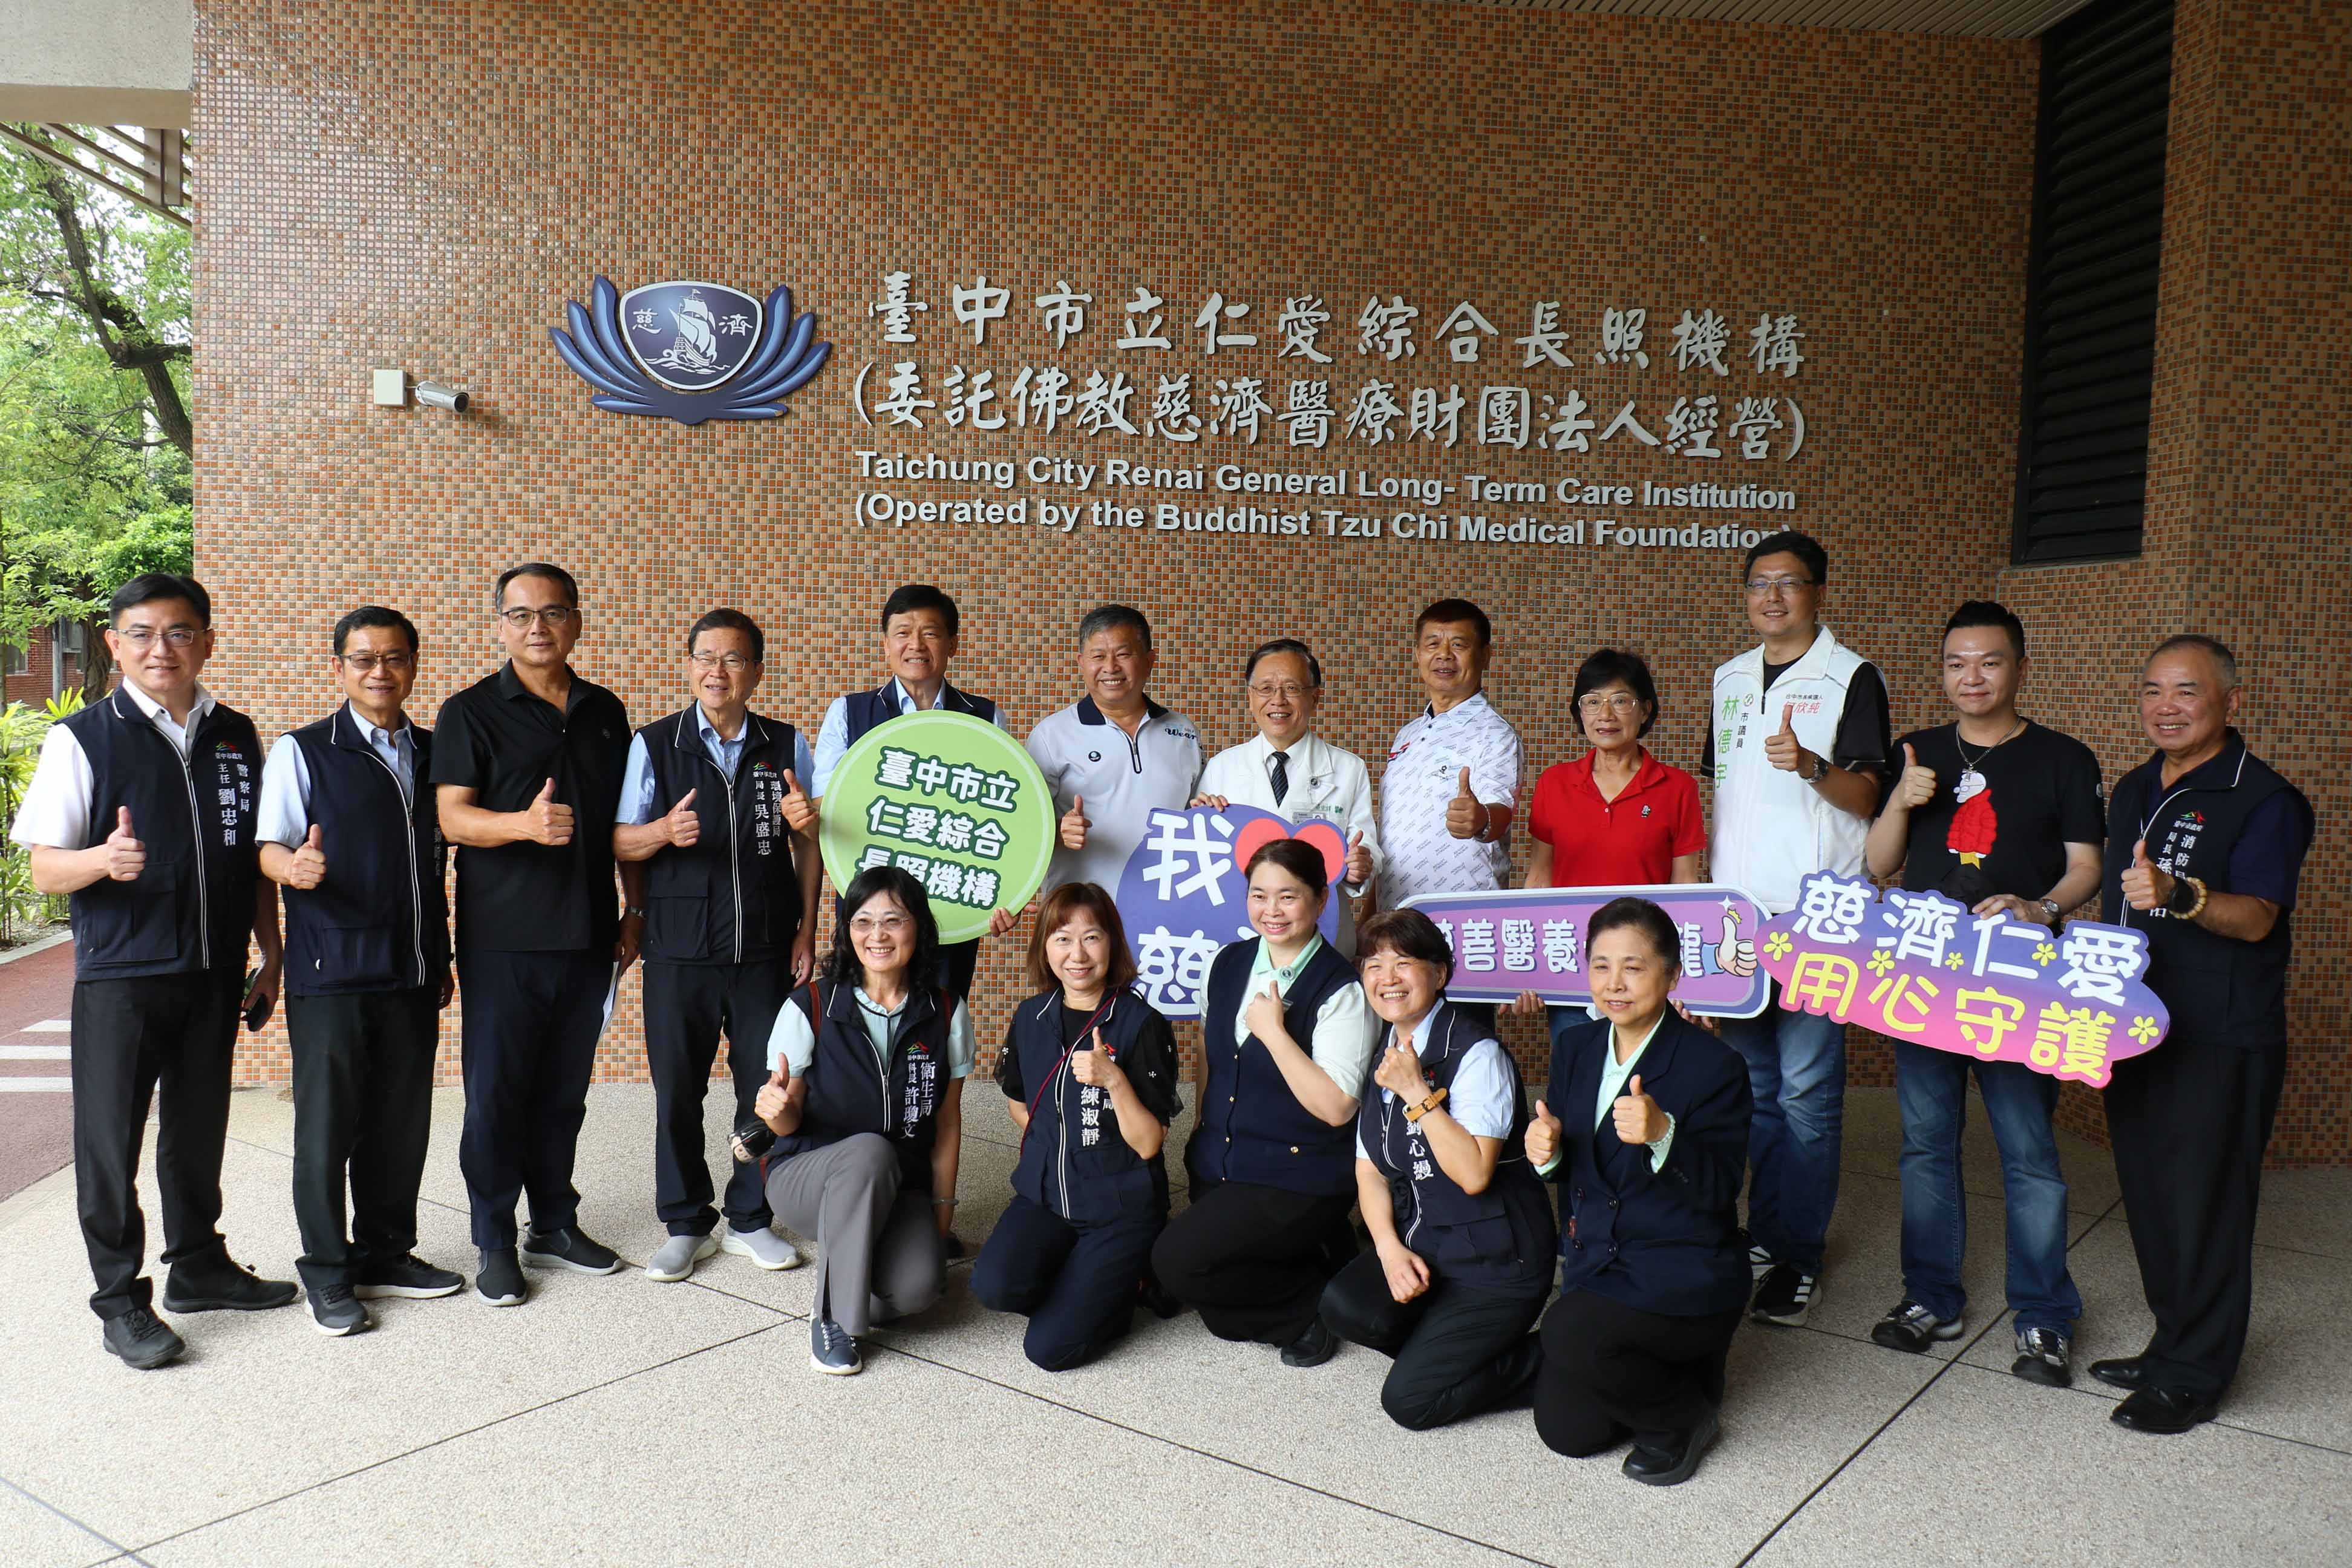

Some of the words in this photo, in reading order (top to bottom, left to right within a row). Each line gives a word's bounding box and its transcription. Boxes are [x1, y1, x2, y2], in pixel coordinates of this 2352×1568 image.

[867, 271, 1805, 378] 臺中市立仁愛綜合長照機構
[855, 451, 1014, 489] Taichung
[1028, 457, 1096, 491] City
[1107, 459, 1204, 489] Renai
[1215, 465, 1346, 495] General
[1464, 475, 1546, 502] Term
[1557, 478, 1633, 506] Care
[1644, 481, 1796, 510] Institution
[855, 493, 1027, 527] (Operated
[1039, 498, 1081, 532] by
[1091, 500, 1145, 528] the
[1157, 503, 1311, 535] Buddhist
[1321, 511, 1381, 537] Tzu
[1392, 512, 1448, 540] Chi
[1459, 515, 1584, 544] Medical
[1595, 520, 1790, 549] Foundatio
[1736, 713, 1749, 749] 市議員
[877, 749, 1017, 810] 臺中市立
[869, 799, 1007, 857] 仁愛綜合
[1142, 812, 1235, 907] 我
[1133, 925, 1260, 1016] 慈
[1791, 875, 2143, 1007] 慈濟仁愛
[1786, 952, 2116, 1082] 用心守護
